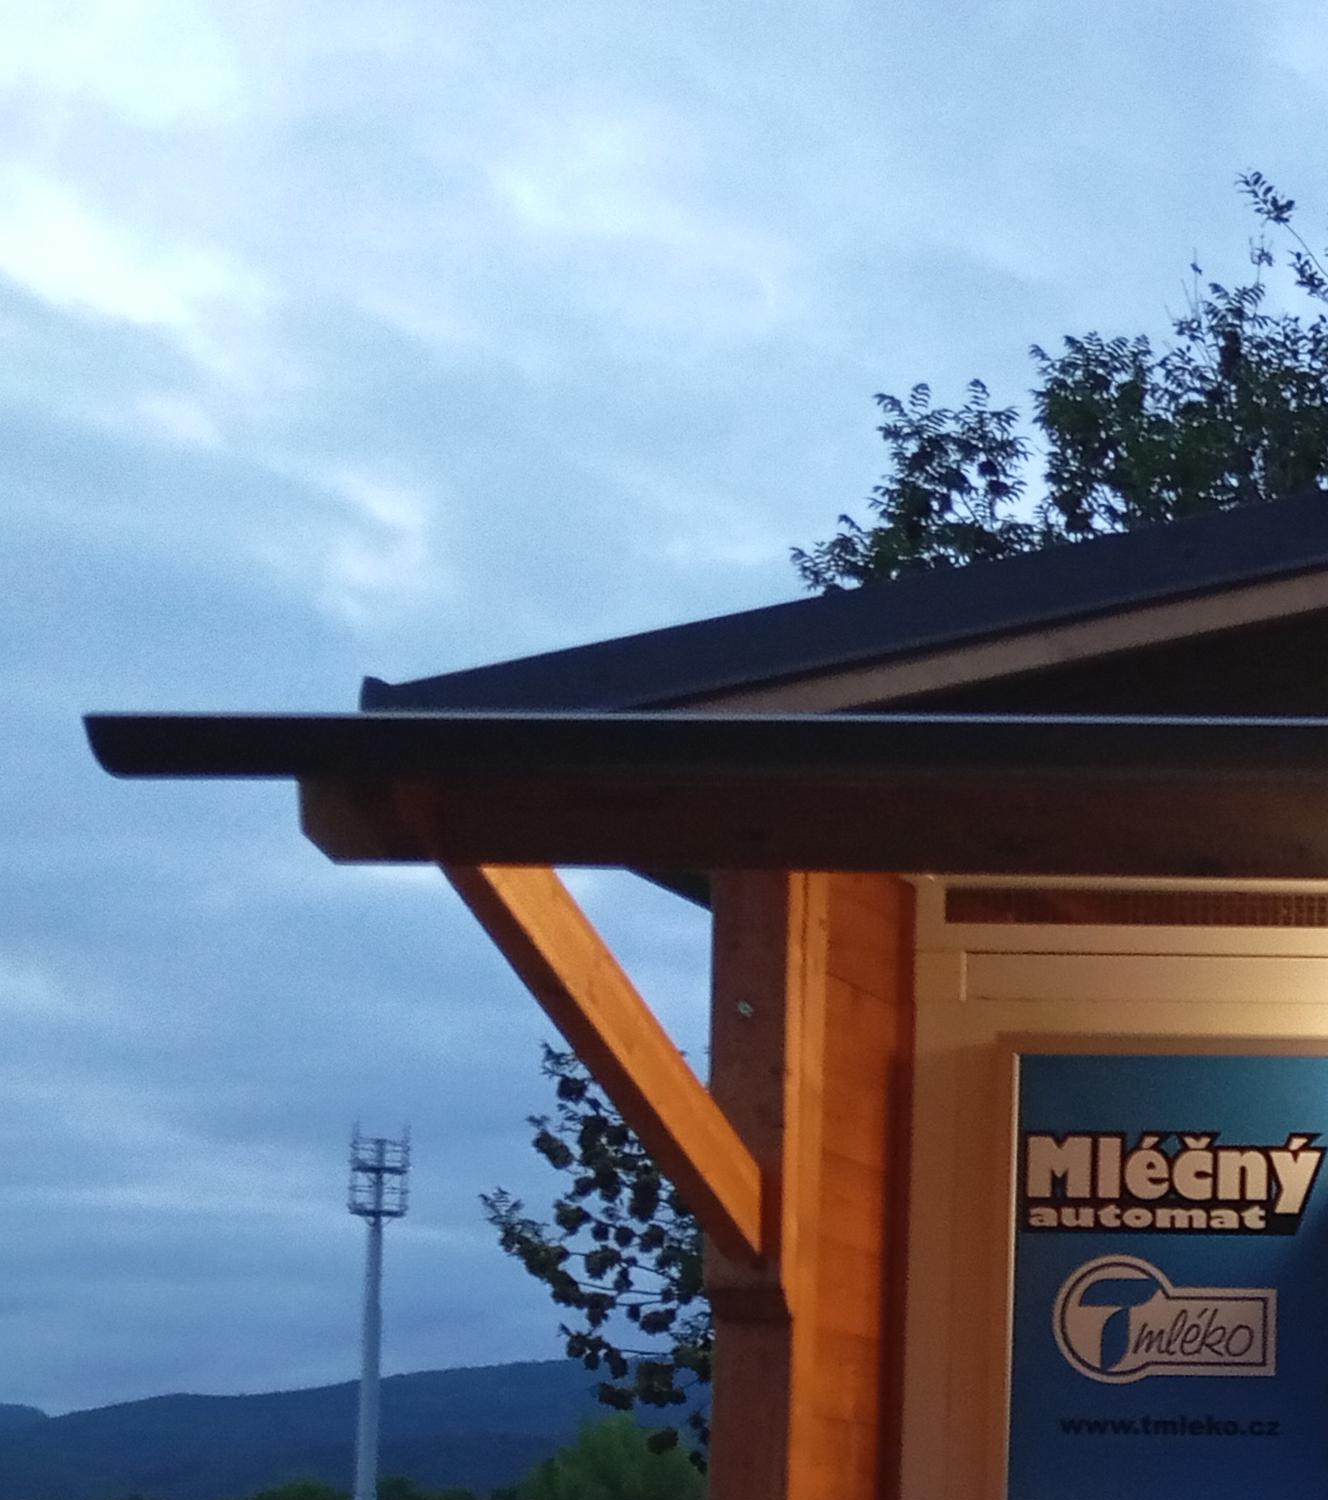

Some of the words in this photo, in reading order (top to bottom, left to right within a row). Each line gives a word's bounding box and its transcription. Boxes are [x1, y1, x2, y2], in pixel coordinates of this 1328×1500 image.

[1027, 1135, 1322, 1214] Mléčný
[1029, 1205, 1267, 1230] automat
[1058, 1414, 1281, 1437] www.tmleko.cz
